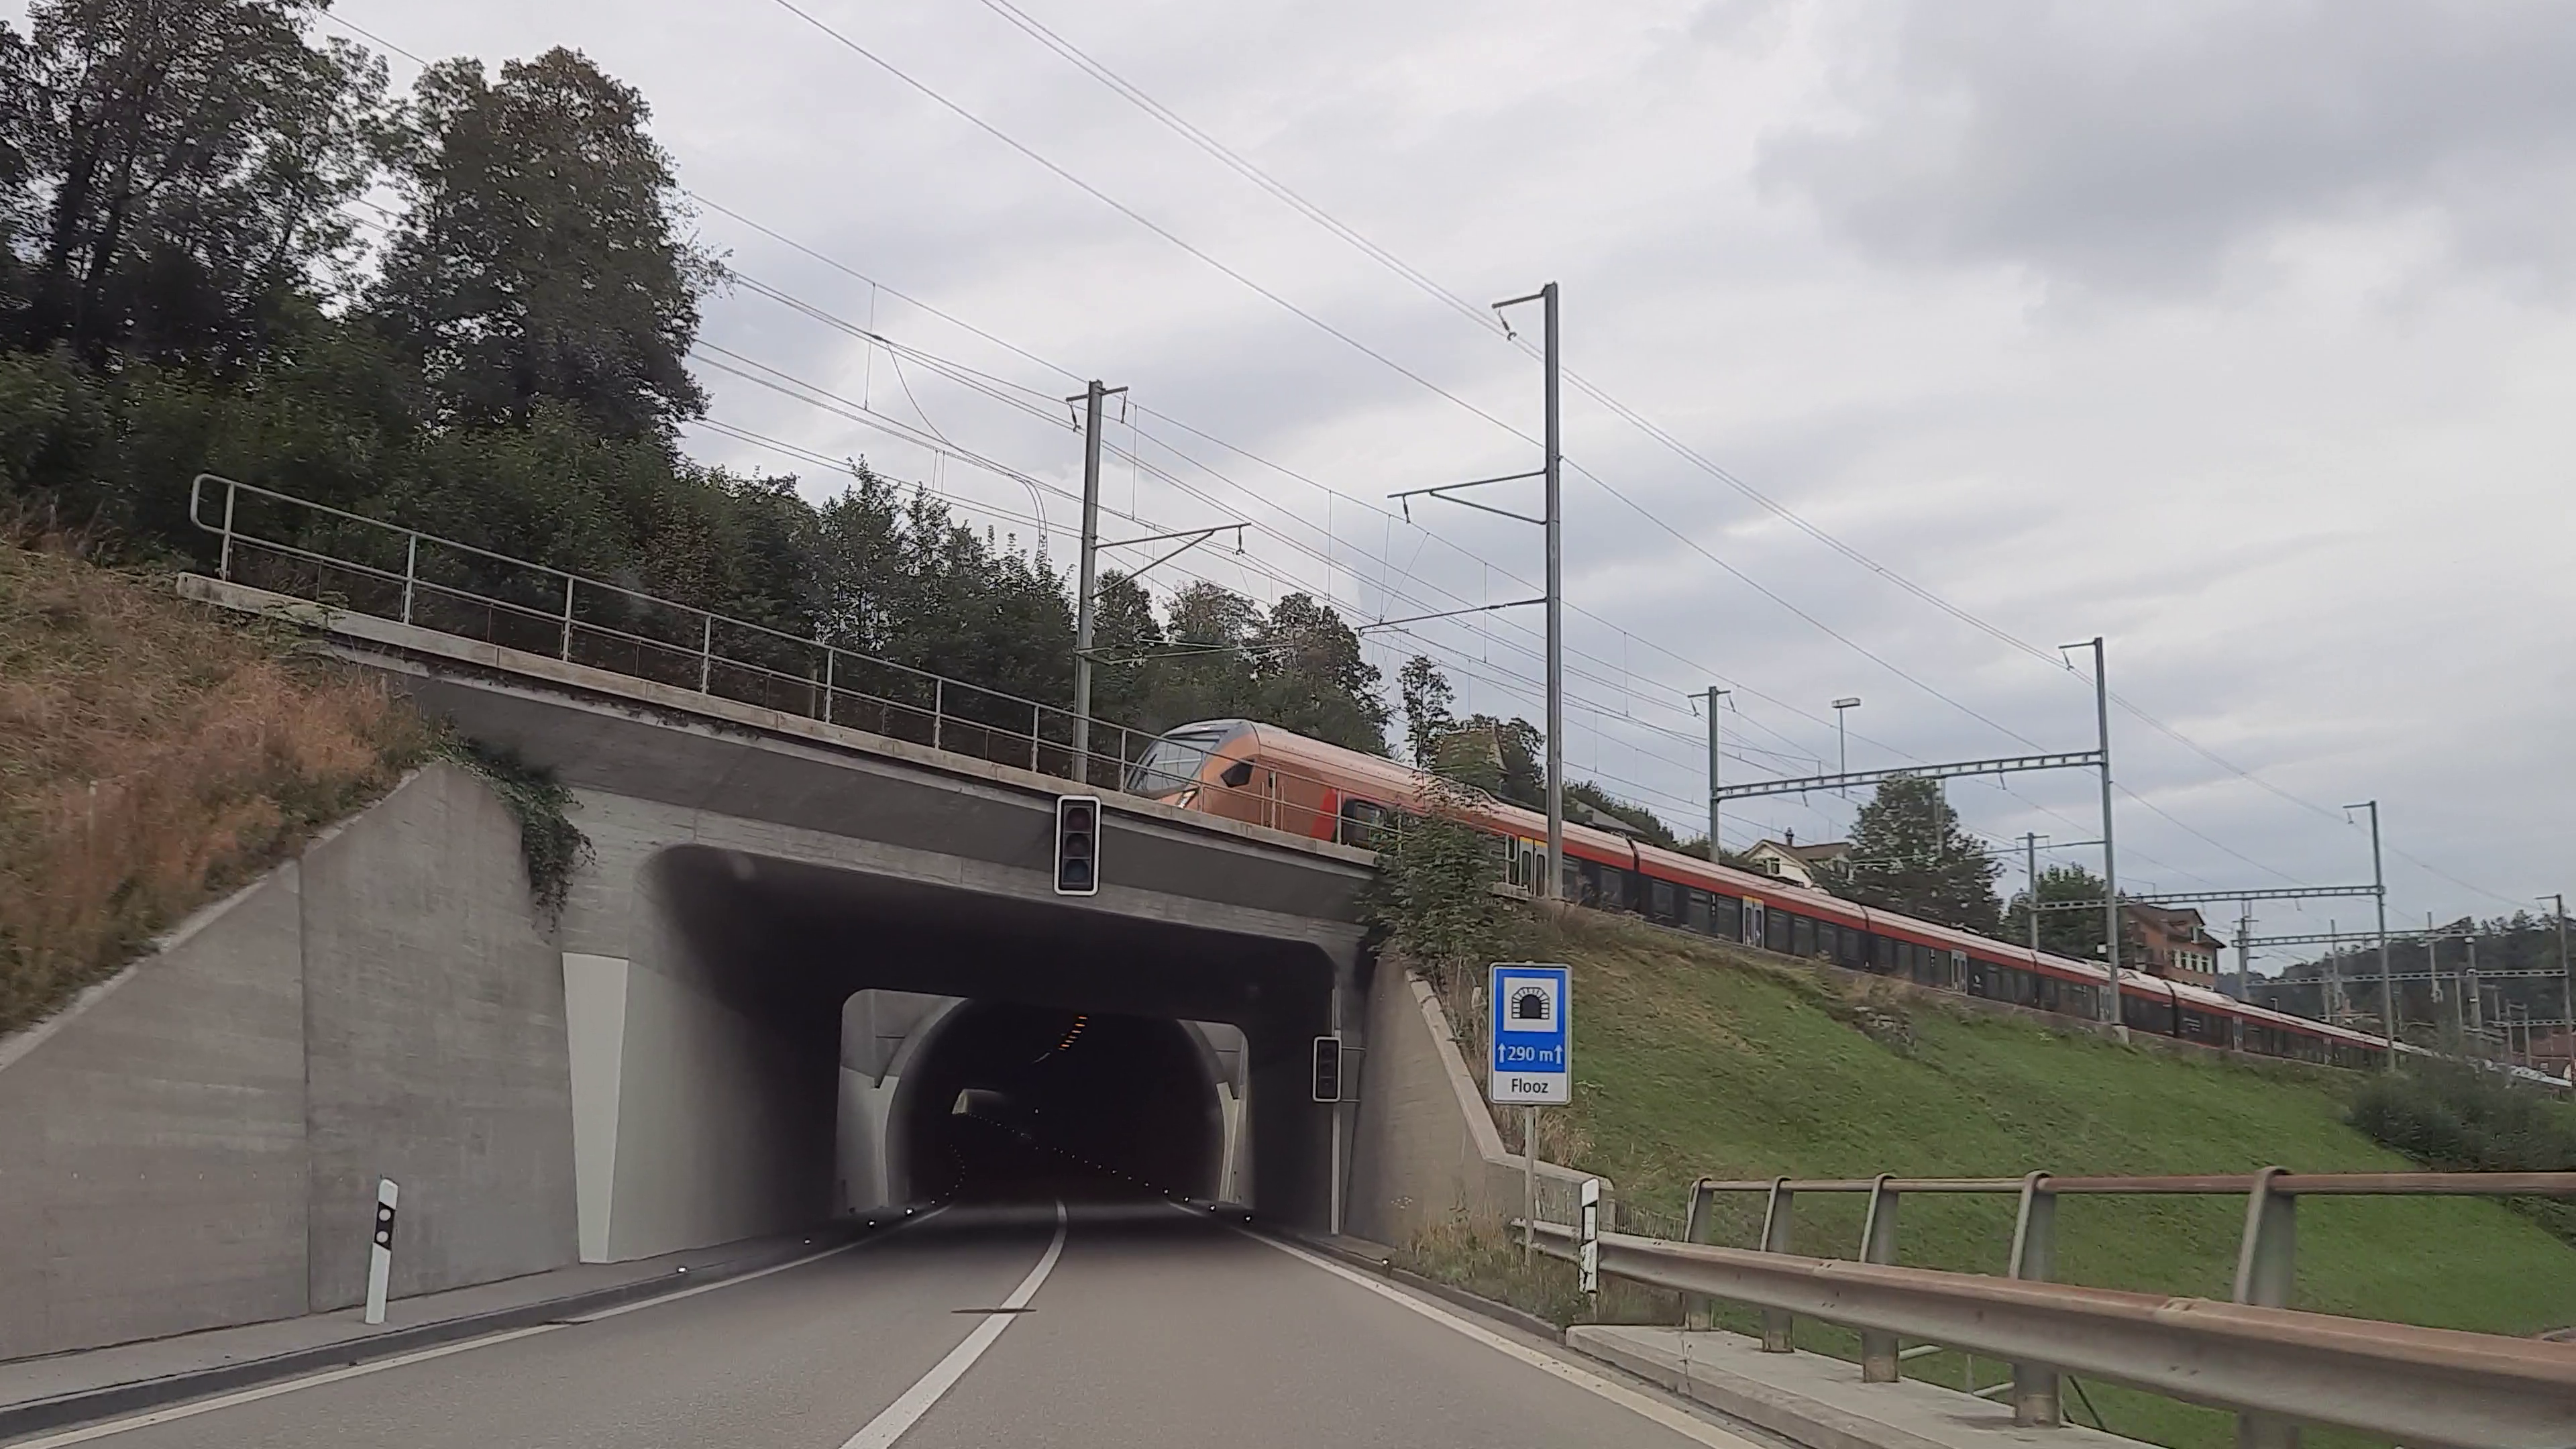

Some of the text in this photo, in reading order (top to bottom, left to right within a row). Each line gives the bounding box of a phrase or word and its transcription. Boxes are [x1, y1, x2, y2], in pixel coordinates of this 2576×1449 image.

[1507, 1046, 1554, 1062] 290 m
[1511, 1078, 1548, 1093] Flooz
